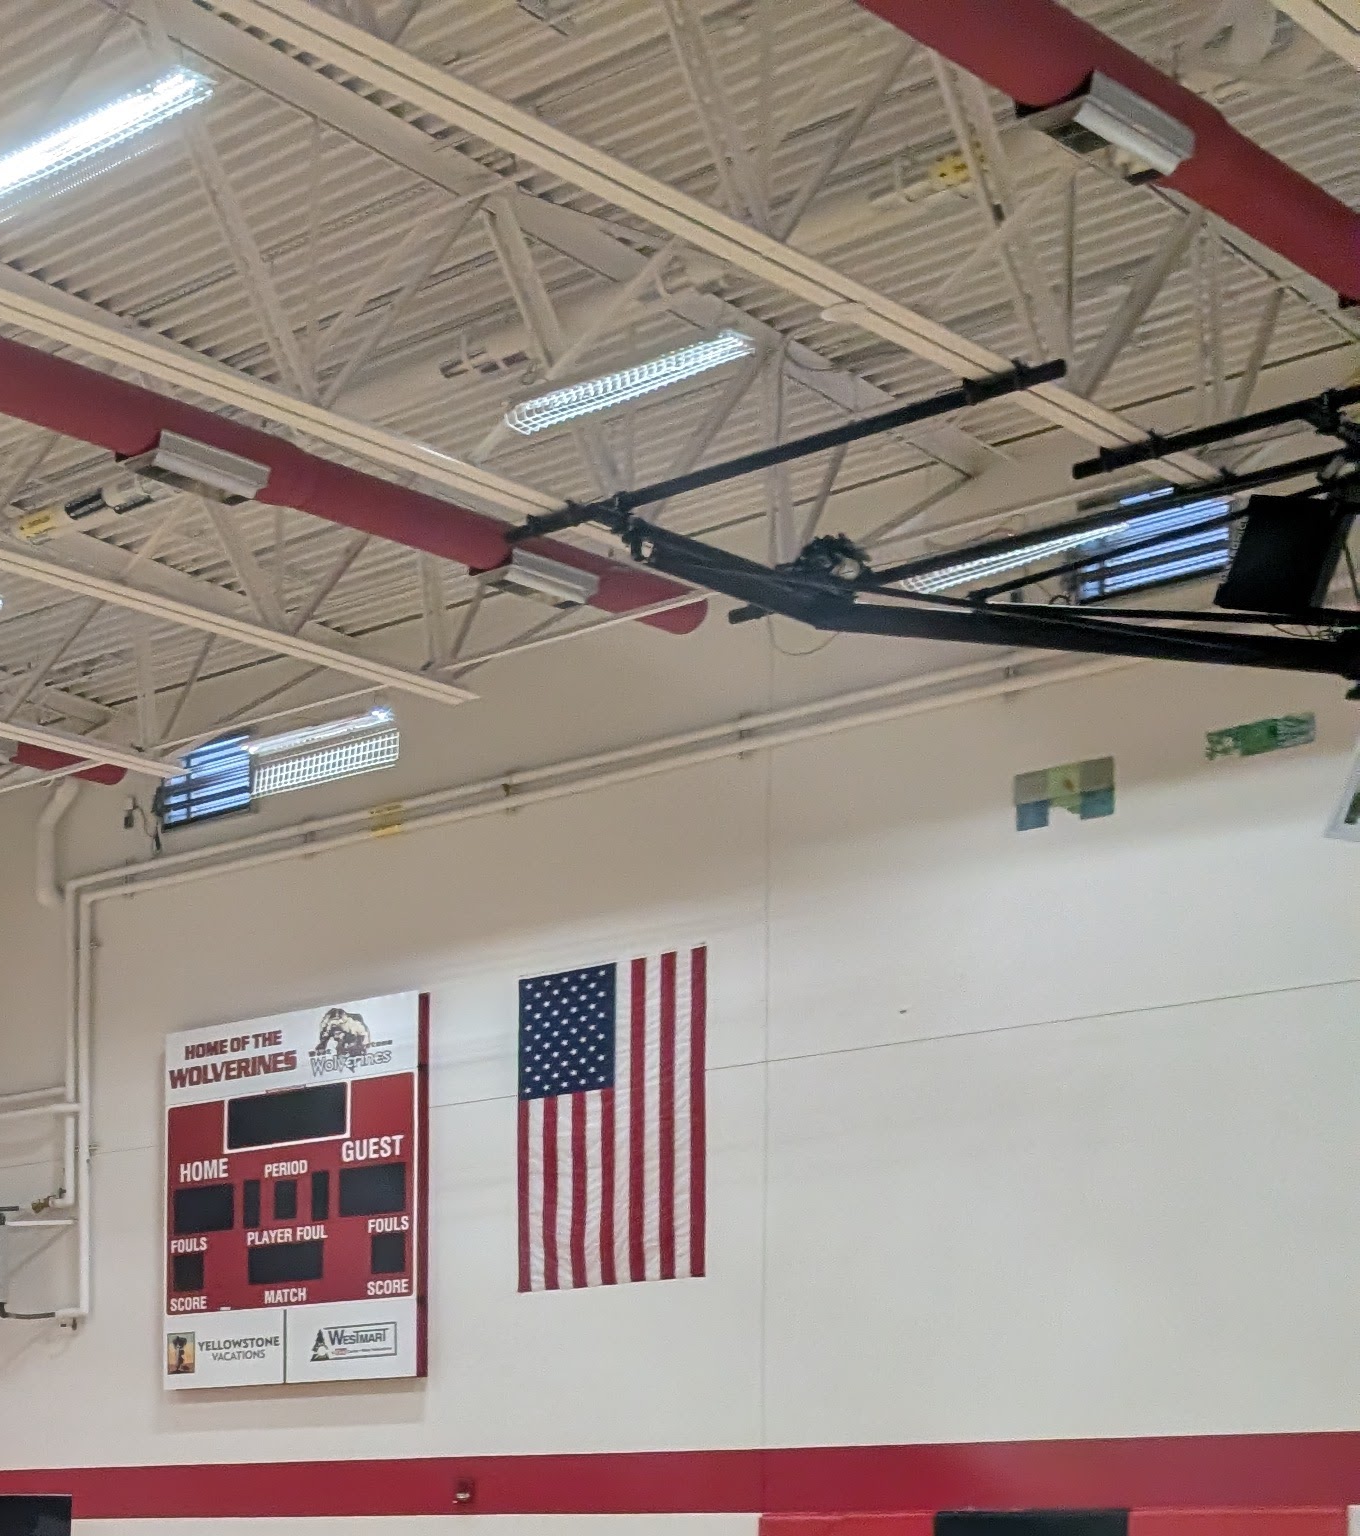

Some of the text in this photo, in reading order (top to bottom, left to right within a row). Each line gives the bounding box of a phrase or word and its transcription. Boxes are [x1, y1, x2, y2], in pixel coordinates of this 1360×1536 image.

[184, 1030, 283, 1060] HOME OF THE
[169, 1050, 298, 1089] WOLVERINES
[309, 1049, 393, 1077] Wolverines
[341, 1134, 405, 1162] GUEST
[180, 1158, 229, 1183] HOME
[264, 1160, 308, 1178] PERIOD
[368, 1215, 410, 1234] FOULS
[246, 1224, 329, 1246] PLAYER FOUL
[170, 1236, 208, 1254] FOULS
[264, 1287, 307, 1305] MATCH
[367, 1278, 409, 1297] SCORE
[170, 1295, 208, 1312] SCORE
[198, 1334, 281, 1353] YELLOWSTONE
[211, 1349, 266, 1362] VACATIONS
